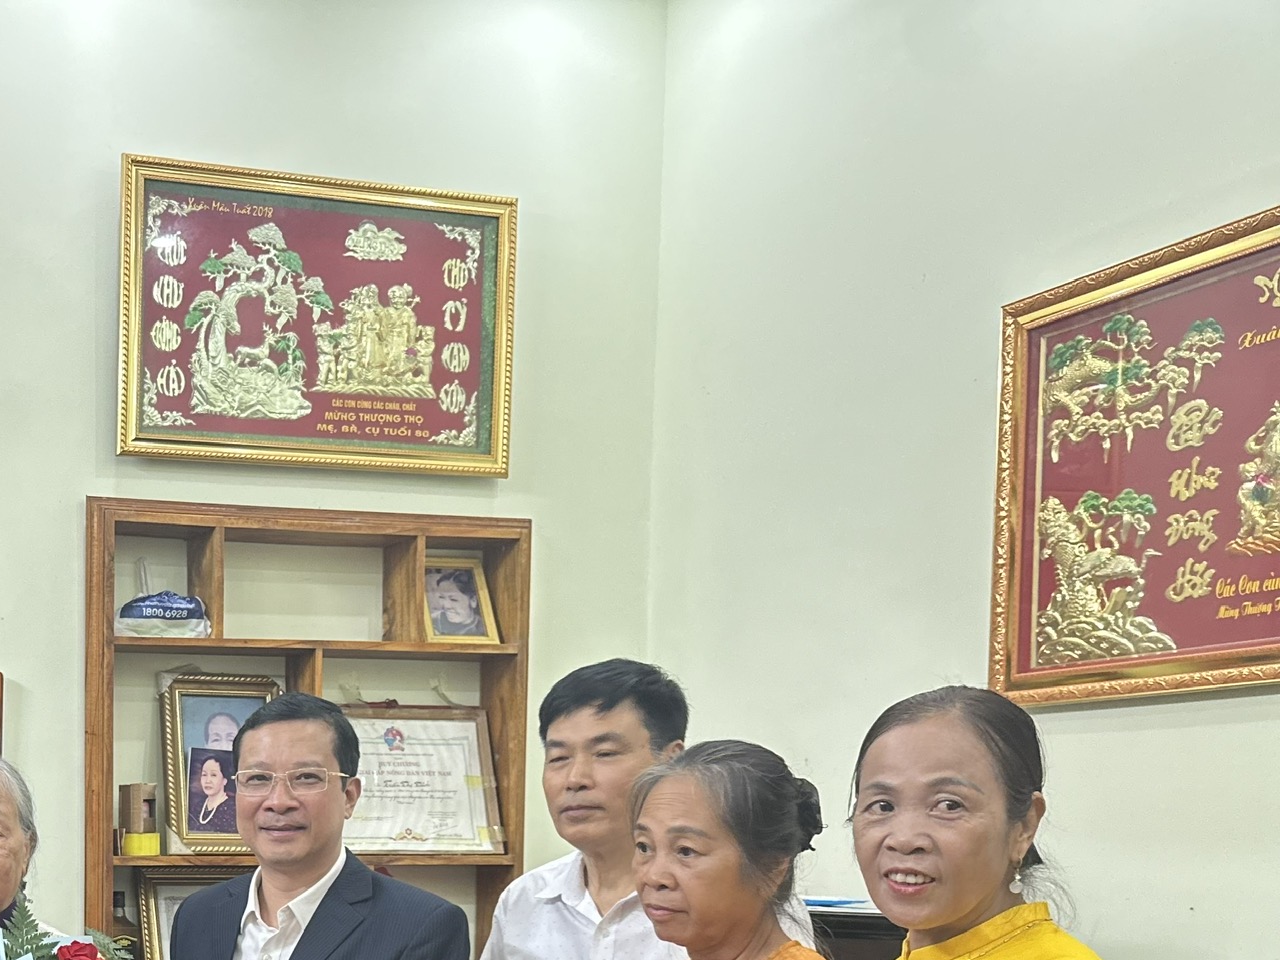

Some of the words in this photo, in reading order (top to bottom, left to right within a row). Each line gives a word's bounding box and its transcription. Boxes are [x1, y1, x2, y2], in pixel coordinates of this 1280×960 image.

[252, 205, 274, 218] 2018
[324, 410, 357, 421] MỪNG
[358, 412, 402, 425] THƯỢNG
[403, 414, 424, 427] THỌ
[316, 423, 338, 434] MẸ,
[365, 426, 380, 437] CỤ
[383, 425, 412, 437] TUỔI
[1215, 577, 1237, 599] Các
[1238, 574, 1260, 596] Con
[142, 607, 164, 617] 1800
[165, 609, 188, 618] 6928
